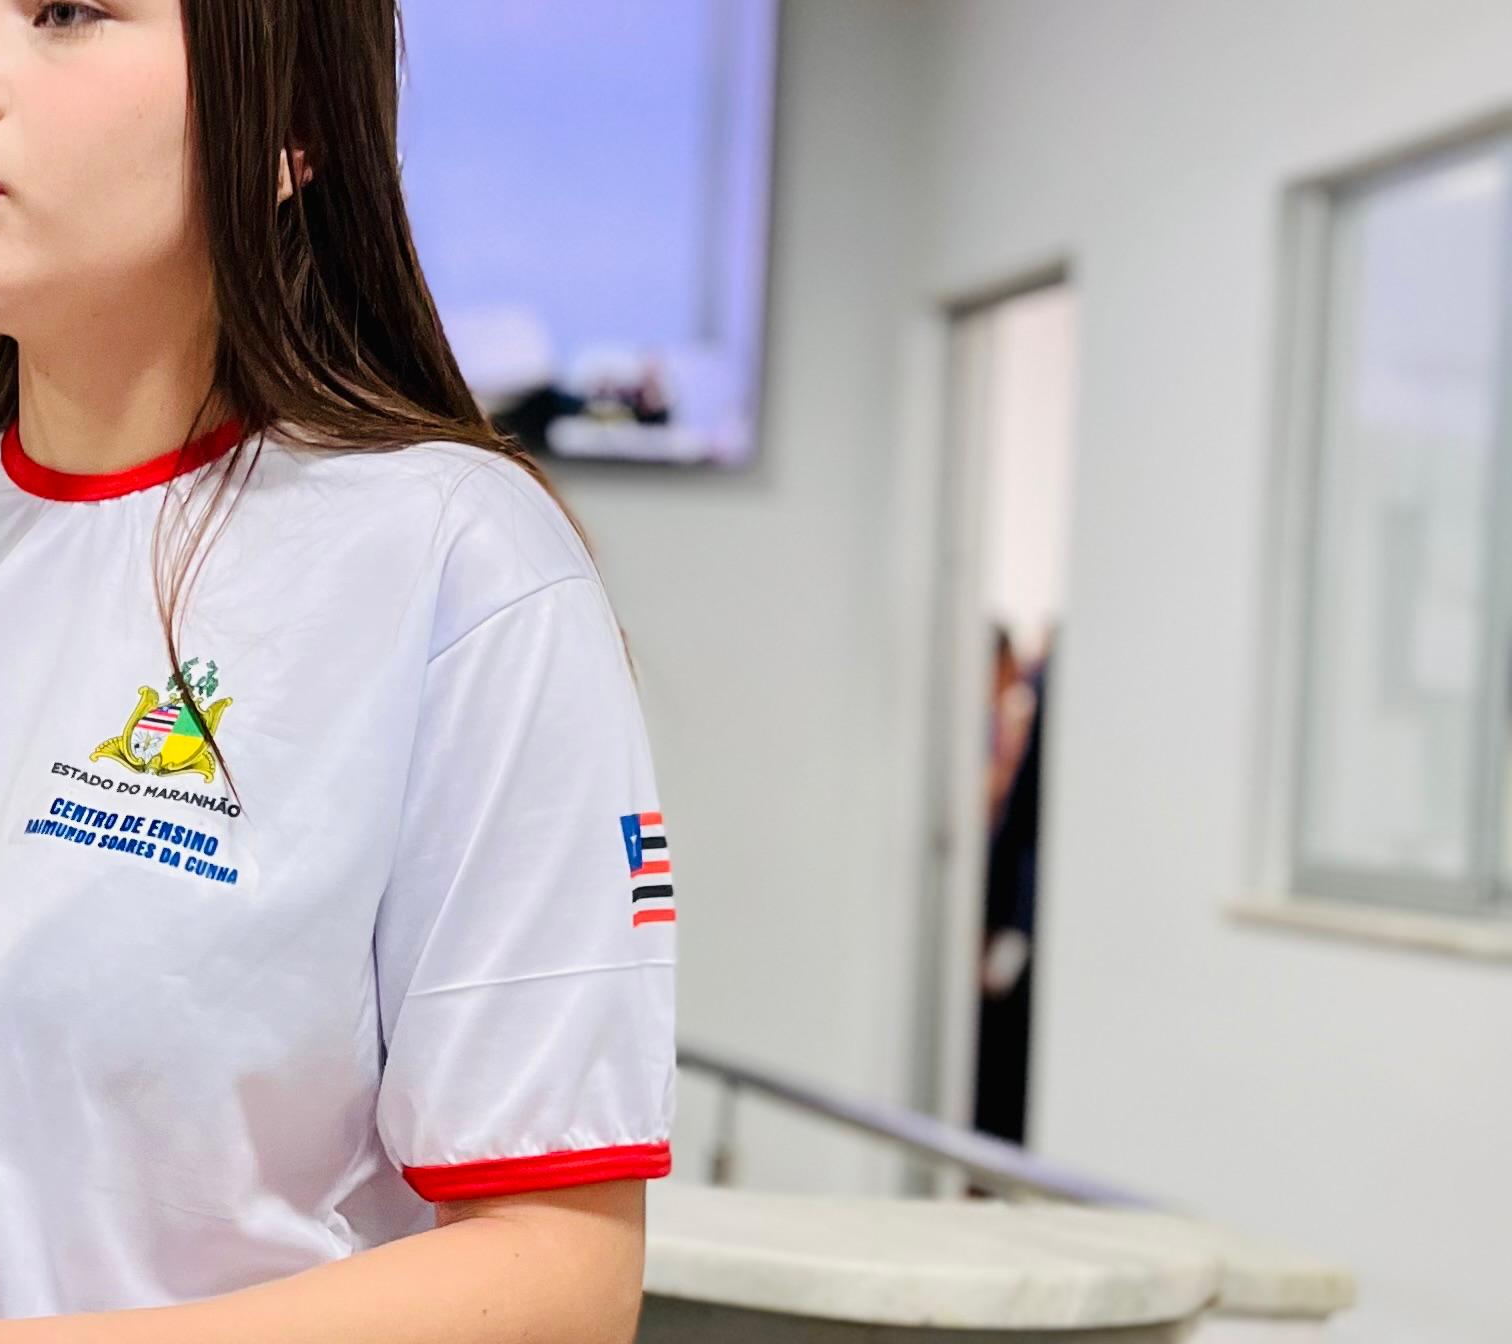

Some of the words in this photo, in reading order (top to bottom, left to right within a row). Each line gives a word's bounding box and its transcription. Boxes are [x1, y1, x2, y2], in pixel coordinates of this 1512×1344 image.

[51, 762, 114, 789] ESTADO
[117, 782, 141, 795] DO
[143, 786, 241, 817] MARANHÃO
[50, 797, 119, 830] CENTRO
[120, 815, 146, 834] DE
[147, 819, 219, 856] ENSINO
[98, 834, 156, 859] SOARES
[159, 847, 181, 868] DA
[184, 856, 239, 885] CUNHA
